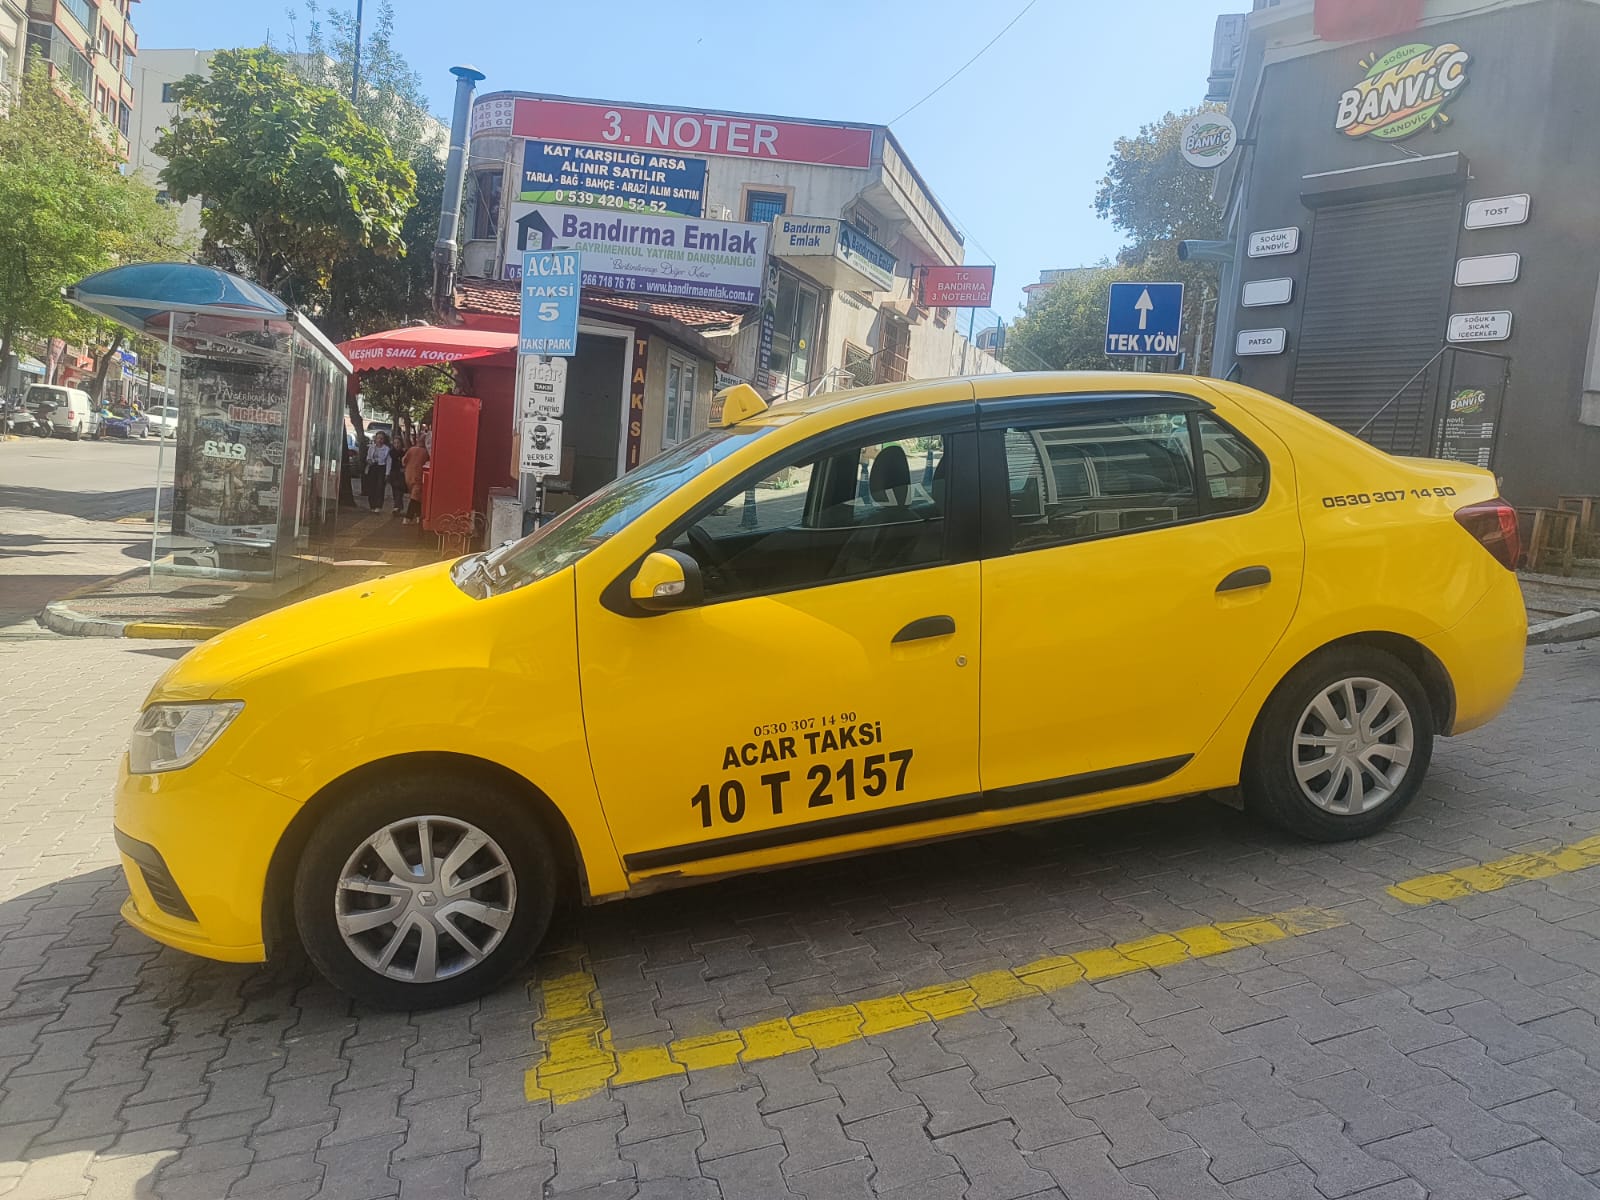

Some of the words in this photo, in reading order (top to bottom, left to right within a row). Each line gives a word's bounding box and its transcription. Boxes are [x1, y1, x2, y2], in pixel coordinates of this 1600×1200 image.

[602, 110, 631, 143] 3.
[645, 114, 779, 156] NOTER
[544, 144, 571, 157] KAT
[575, 148, 645, 166] KARŞILIĞI
[649, 157, 686, 170] ARSA
[561, 161, 608, 176] ALINIR
[613, 166, 666, 183] SATILIR
[526, 171, 553, 184] TARLA
[561, 174, 578, 186] BAĞ
[585, 178, 615, 191] BAHÇE
[621, 181, 648, 194] ARAZİ
[649, 187, 671, 197] ALIM
[673, 188, 699, 201] SATIM
[555, 189, 563, 201] 0
[568, 191, 594, 205] 539
[597, 194, 624, 208] 420
[628, 199, 645, 211] 52
[650, 200, 667, 213] 52
[1485, 207, 1509, 216] TOST
[562, 213, 675, 247] Bandırma
[683, 225, 757, 255] Emlak
[783, 222, 831, 234] Bandırma
[1260, 234, 1287, 243] SOĞUK
[789, 235, 821, 247] Emlak
[575, 241, 644, 258] GAYRİMENKUL
[646, 247, 684, 261] YATIRIM
[687, 252, 757, 268] DANIŞMANLIĞI
[526, 255, 576, 277] ACAR
[526, 283, 574, 297] TAKSİ
[582, 273, 597, 286] 266
[599, 275, 612, 287] 718
[614, 277, 624, 288] 76
[626, 278, 636, 290] 76
[646, 280, 754, 302] www.bandirmaemlak.com.tr
[937, 282, 986, 291] BANDIRMA
[537, 302, 560, 321] 5
[547, 339, 571, 350] PARK
[1109, 334, 1139, 351] TEK
[1144, 331, 1177, 352] YÖN
[348, 347, 384, 361] MEŞHUR
[385, 347, 417, 358] SAHİL
[1321, 494, 1371, 509] 0530
[1373, 490, 1406, 503] 307
[1410, 488, 1432, 499] 14
[1432, 487, 1457, 497] 90
[753, 722, 787, 737] 0530
[791, 718, 816, 732] 307
[821, 714, 836, 727] 14
[840, 711, 857, 724] 90
[722, 736, 798, 770] ACAR
[691, 779, 746, 828] 10
[760, 771, 791, 815] T
[806, 748, 914, 809] 2157
